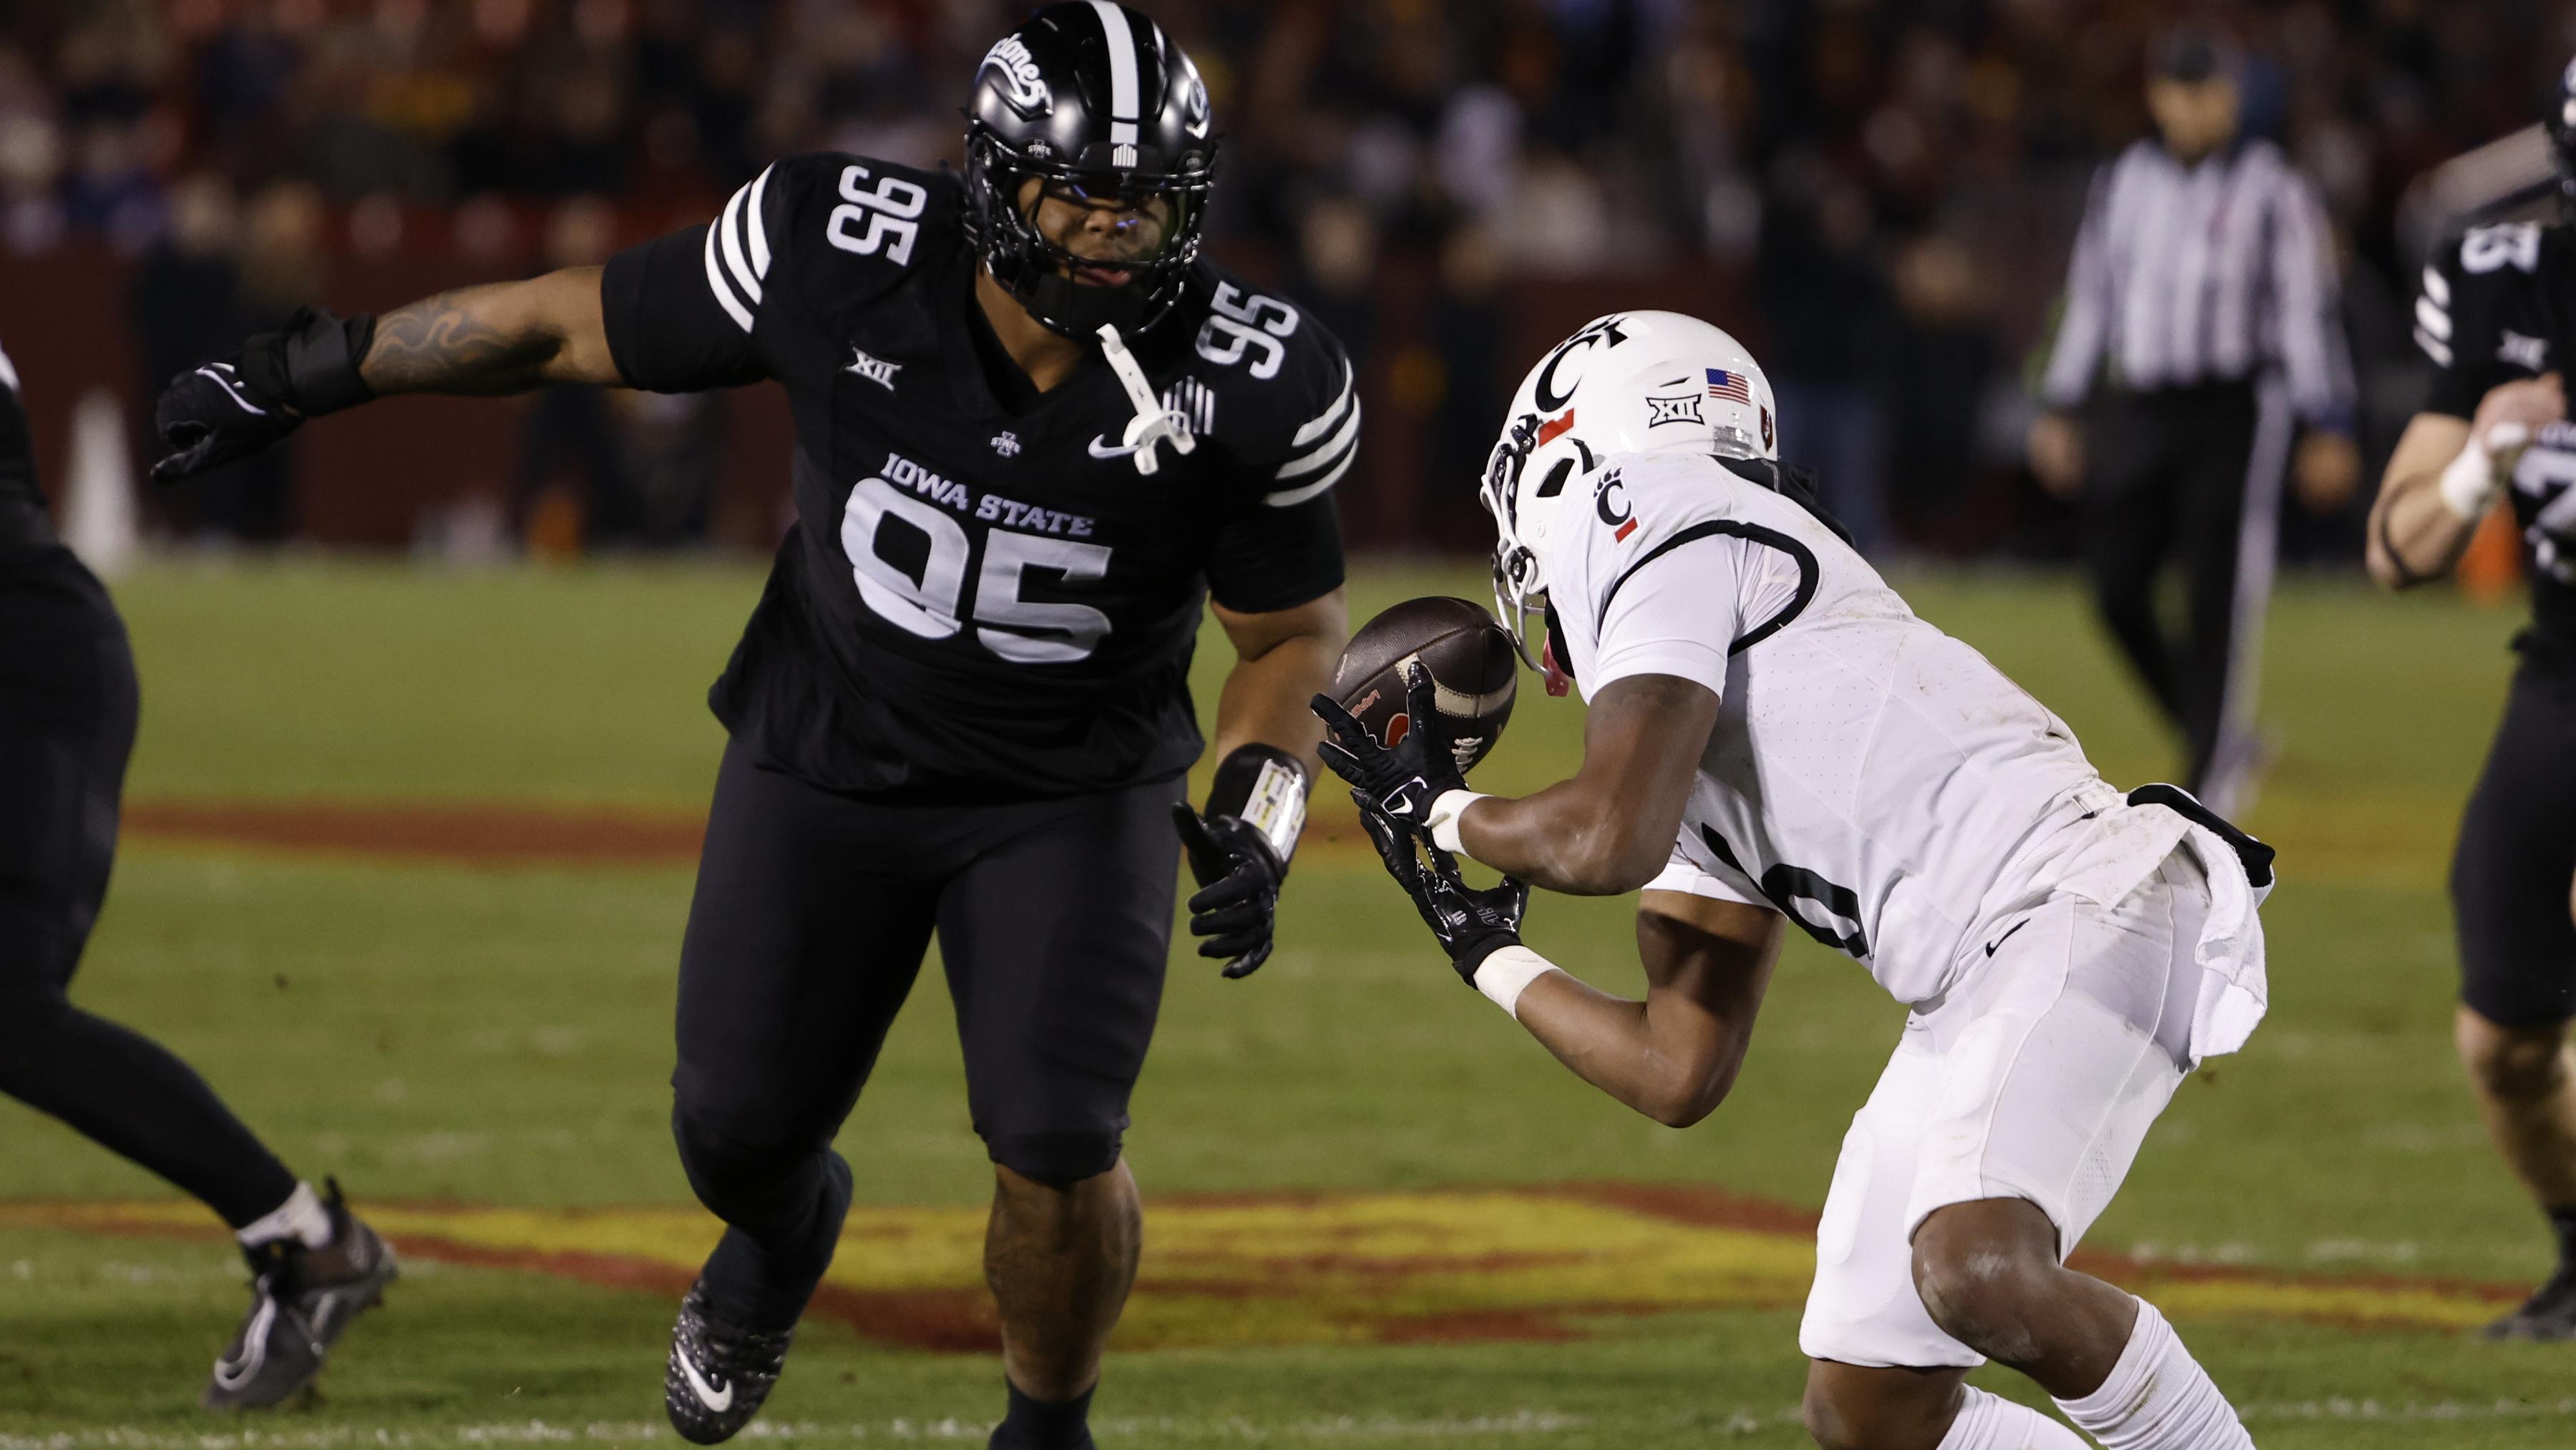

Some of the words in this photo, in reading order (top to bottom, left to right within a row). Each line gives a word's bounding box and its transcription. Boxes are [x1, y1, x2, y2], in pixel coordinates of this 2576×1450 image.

[826, 165, 927, 266] 95
[1196, 281, 1299, 379] 95
[1646, 393, 1705, 428] XII
[880, 452, 970, 511] IOWA
[975, 494, 1096, 537] STATE
[840, 477, 1113, 664] 95
